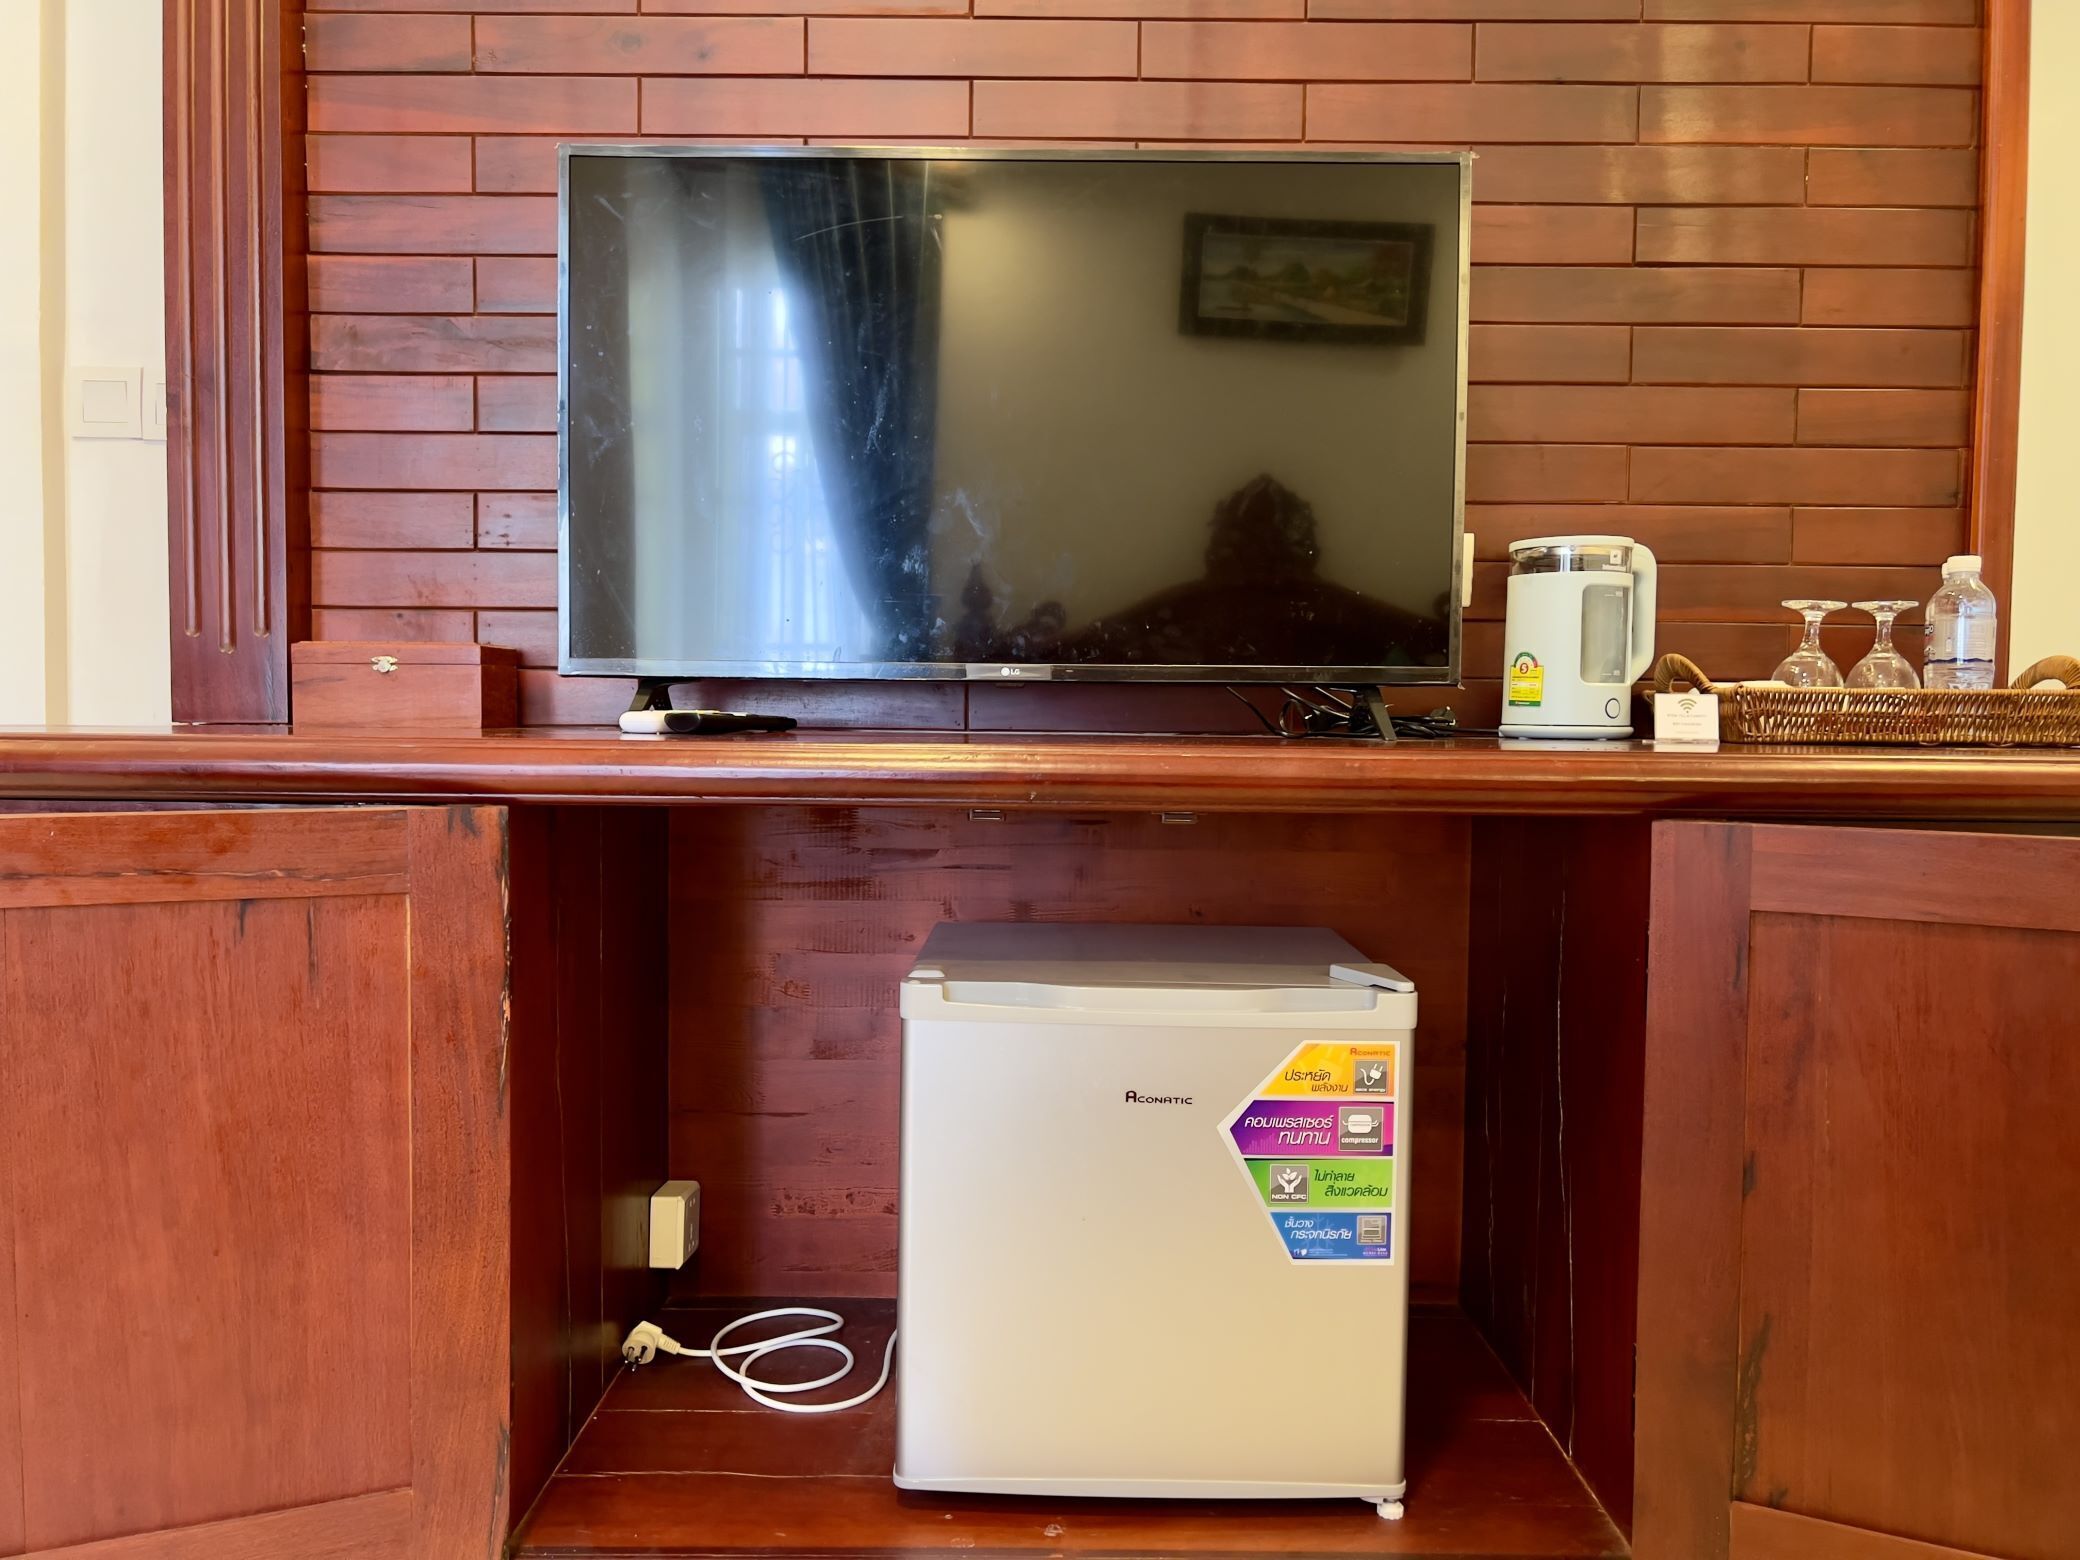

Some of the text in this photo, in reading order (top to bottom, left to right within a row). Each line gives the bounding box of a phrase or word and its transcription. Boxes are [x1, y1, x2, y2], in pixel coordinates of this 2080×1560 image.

[1284, 1068, 1331, 1082] ประหยัด
[1311, 1082, 1349, 1092] พลังงาน
[1244, 1114, 1335, 1129] คอมเพรสเซอร์
[1277, 1131, 1331, 1146] ทนทาน
[1341, 1137, 1379, 1145] compressor
[1314, 1169, 1355, 1182] ไม่ทำลาย
[1324, 1182, 1388, 1197] สิ่งแวดล้อม
[1284, 1216, 1314, 1228] ชั้นวาง
[1290, 1228, 1352, 1240] กระจกนิรภัย
